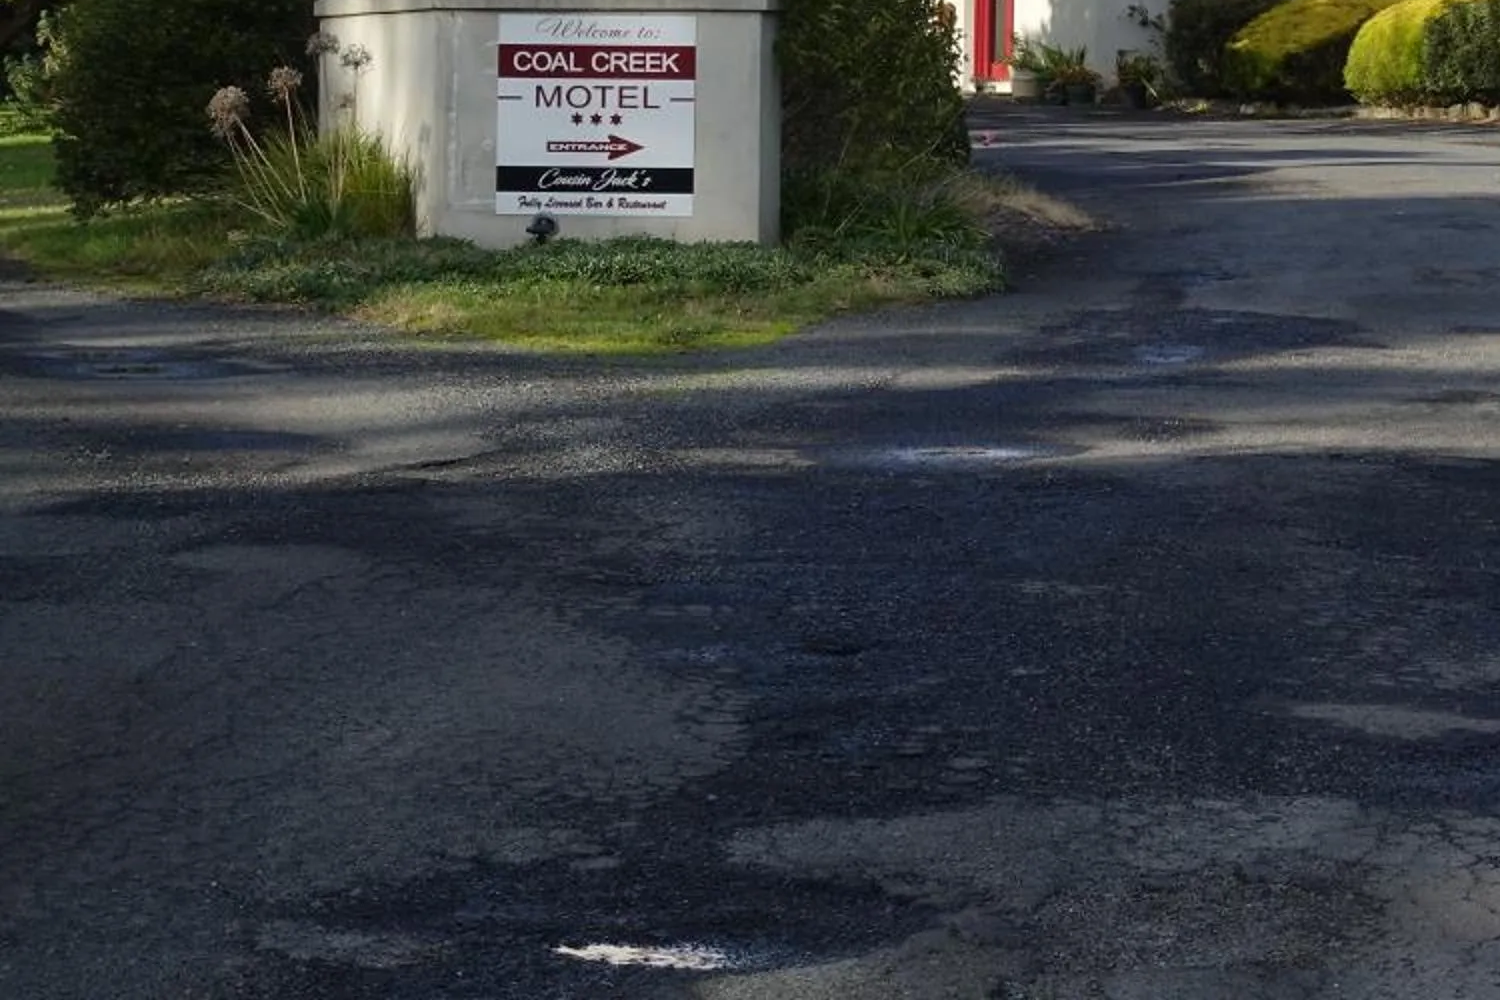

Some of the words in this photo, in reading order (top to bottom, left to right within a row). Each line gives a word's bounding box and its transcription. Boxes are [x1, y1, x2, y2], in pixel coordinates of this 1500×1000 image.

[535, 17, 632, 39] Welcome
[637, 26, 661, 39] to:
[513, 51, 585, 73] COAL
[591, 52, 680, 74] CREEK
[535, 85, 661, 109] MOTEL
[549, 142, 630, 152] ENTRANCE
[537, 167, 592, 189] Cousin
[592, 167, 653, 191] Jack's
[518, 195, 542, 210] Fully
[586, 196, 603, 209] Bar
